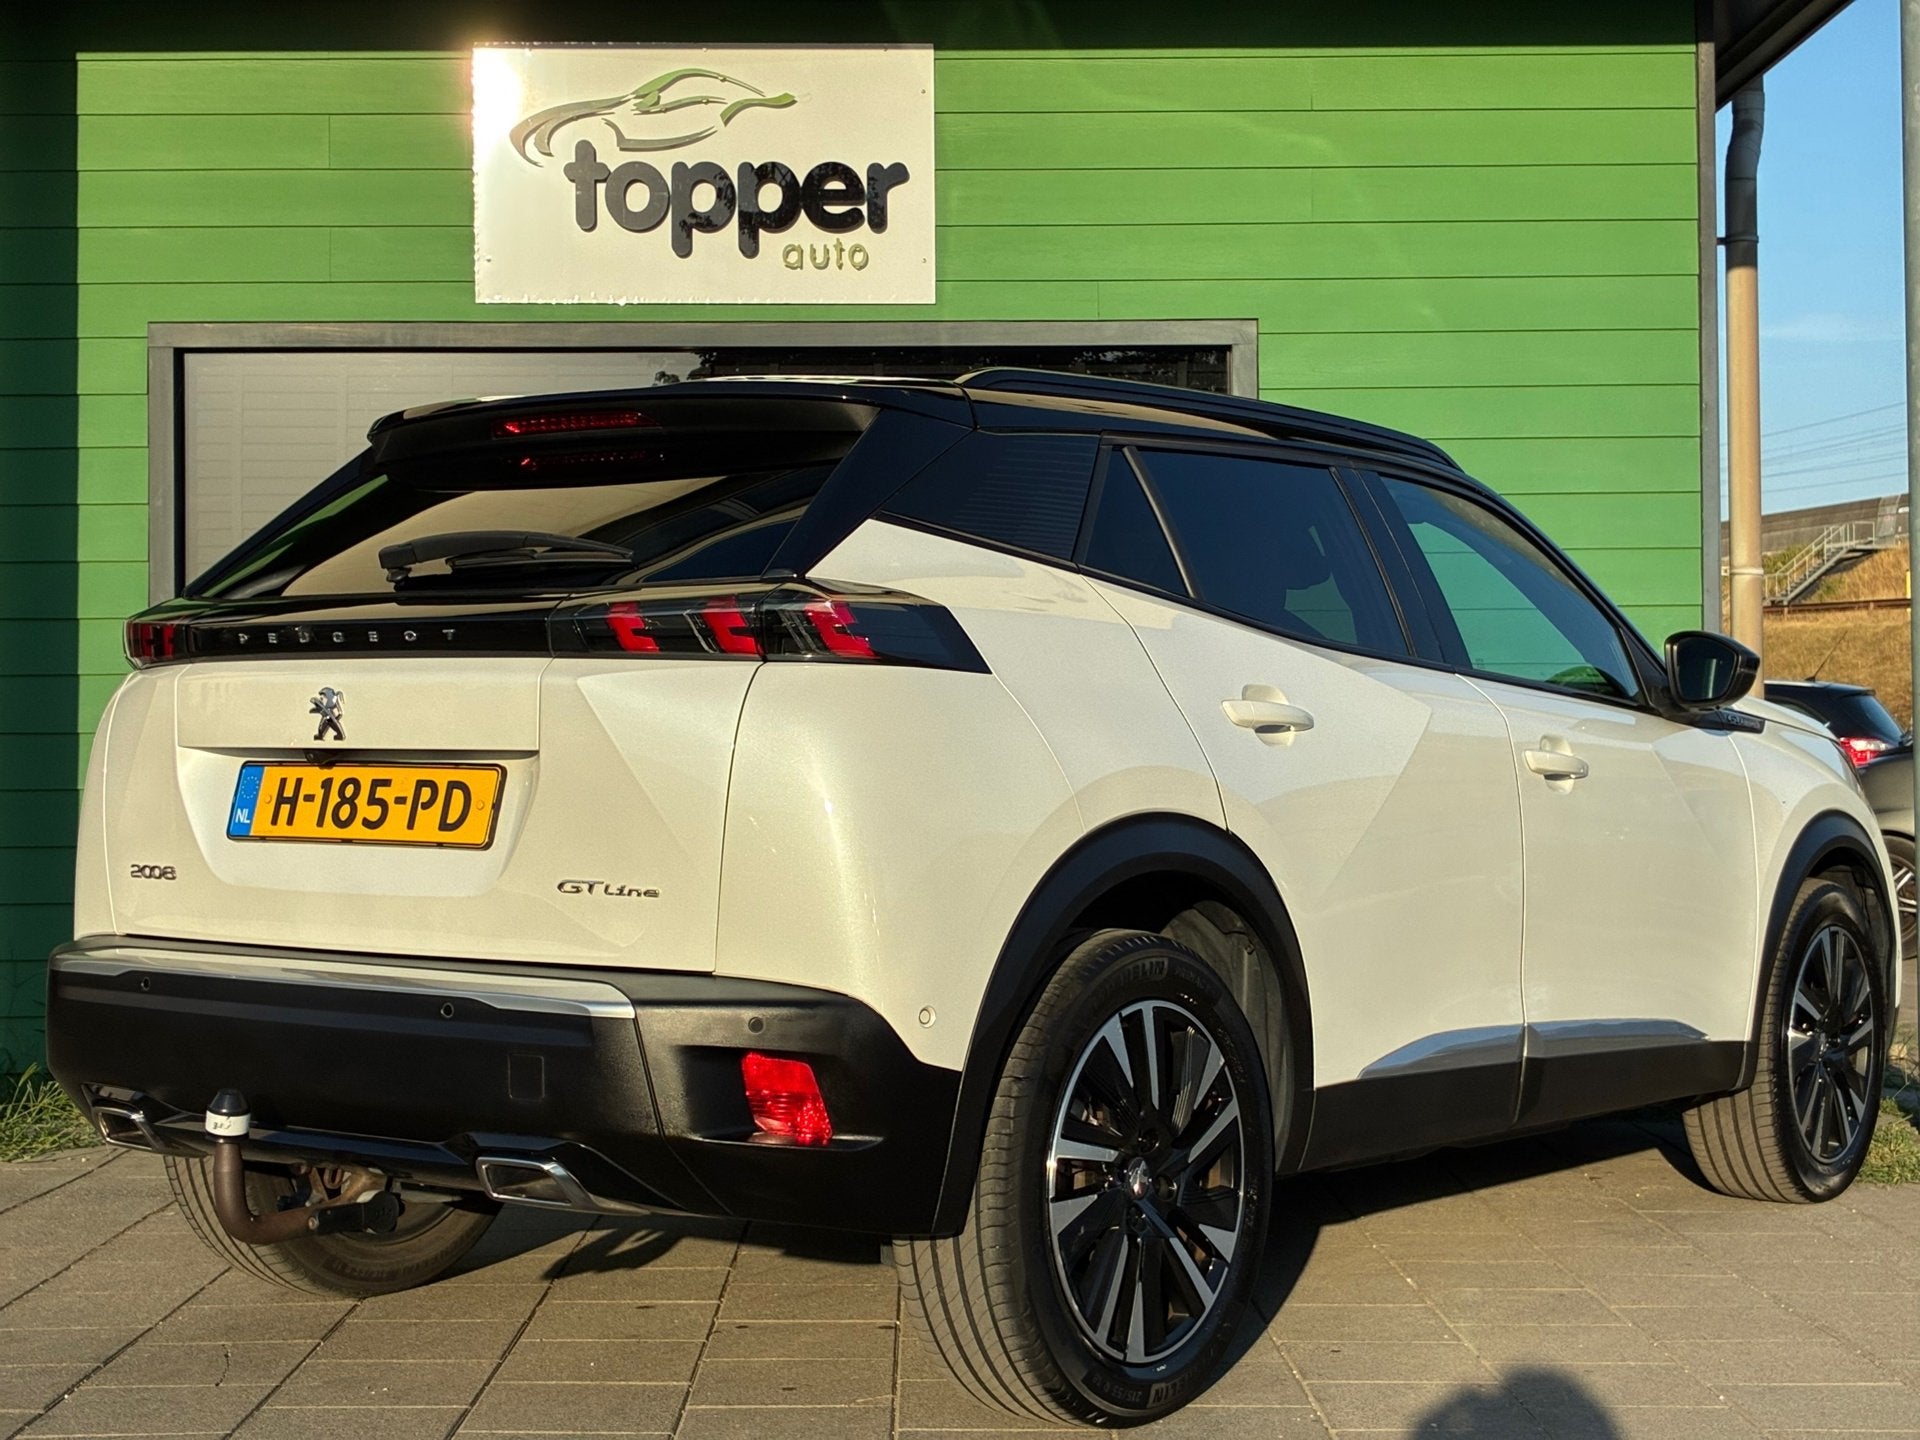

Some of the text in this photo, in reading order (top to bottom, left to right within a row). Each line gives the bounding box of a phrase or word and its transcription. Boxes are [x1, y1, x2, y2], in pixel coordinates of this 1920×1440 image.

[563, 138, 910, 259] topper
[782, 238, 870, 270] auto
[238, 628, 456, 643] PEUGEOT
[270, 777, 472, 832] H-185-PD
[235, 808, 251, 824] NL
[130, 864, 177, 880] 2008
[557, 880, 660, 898] GT Line
